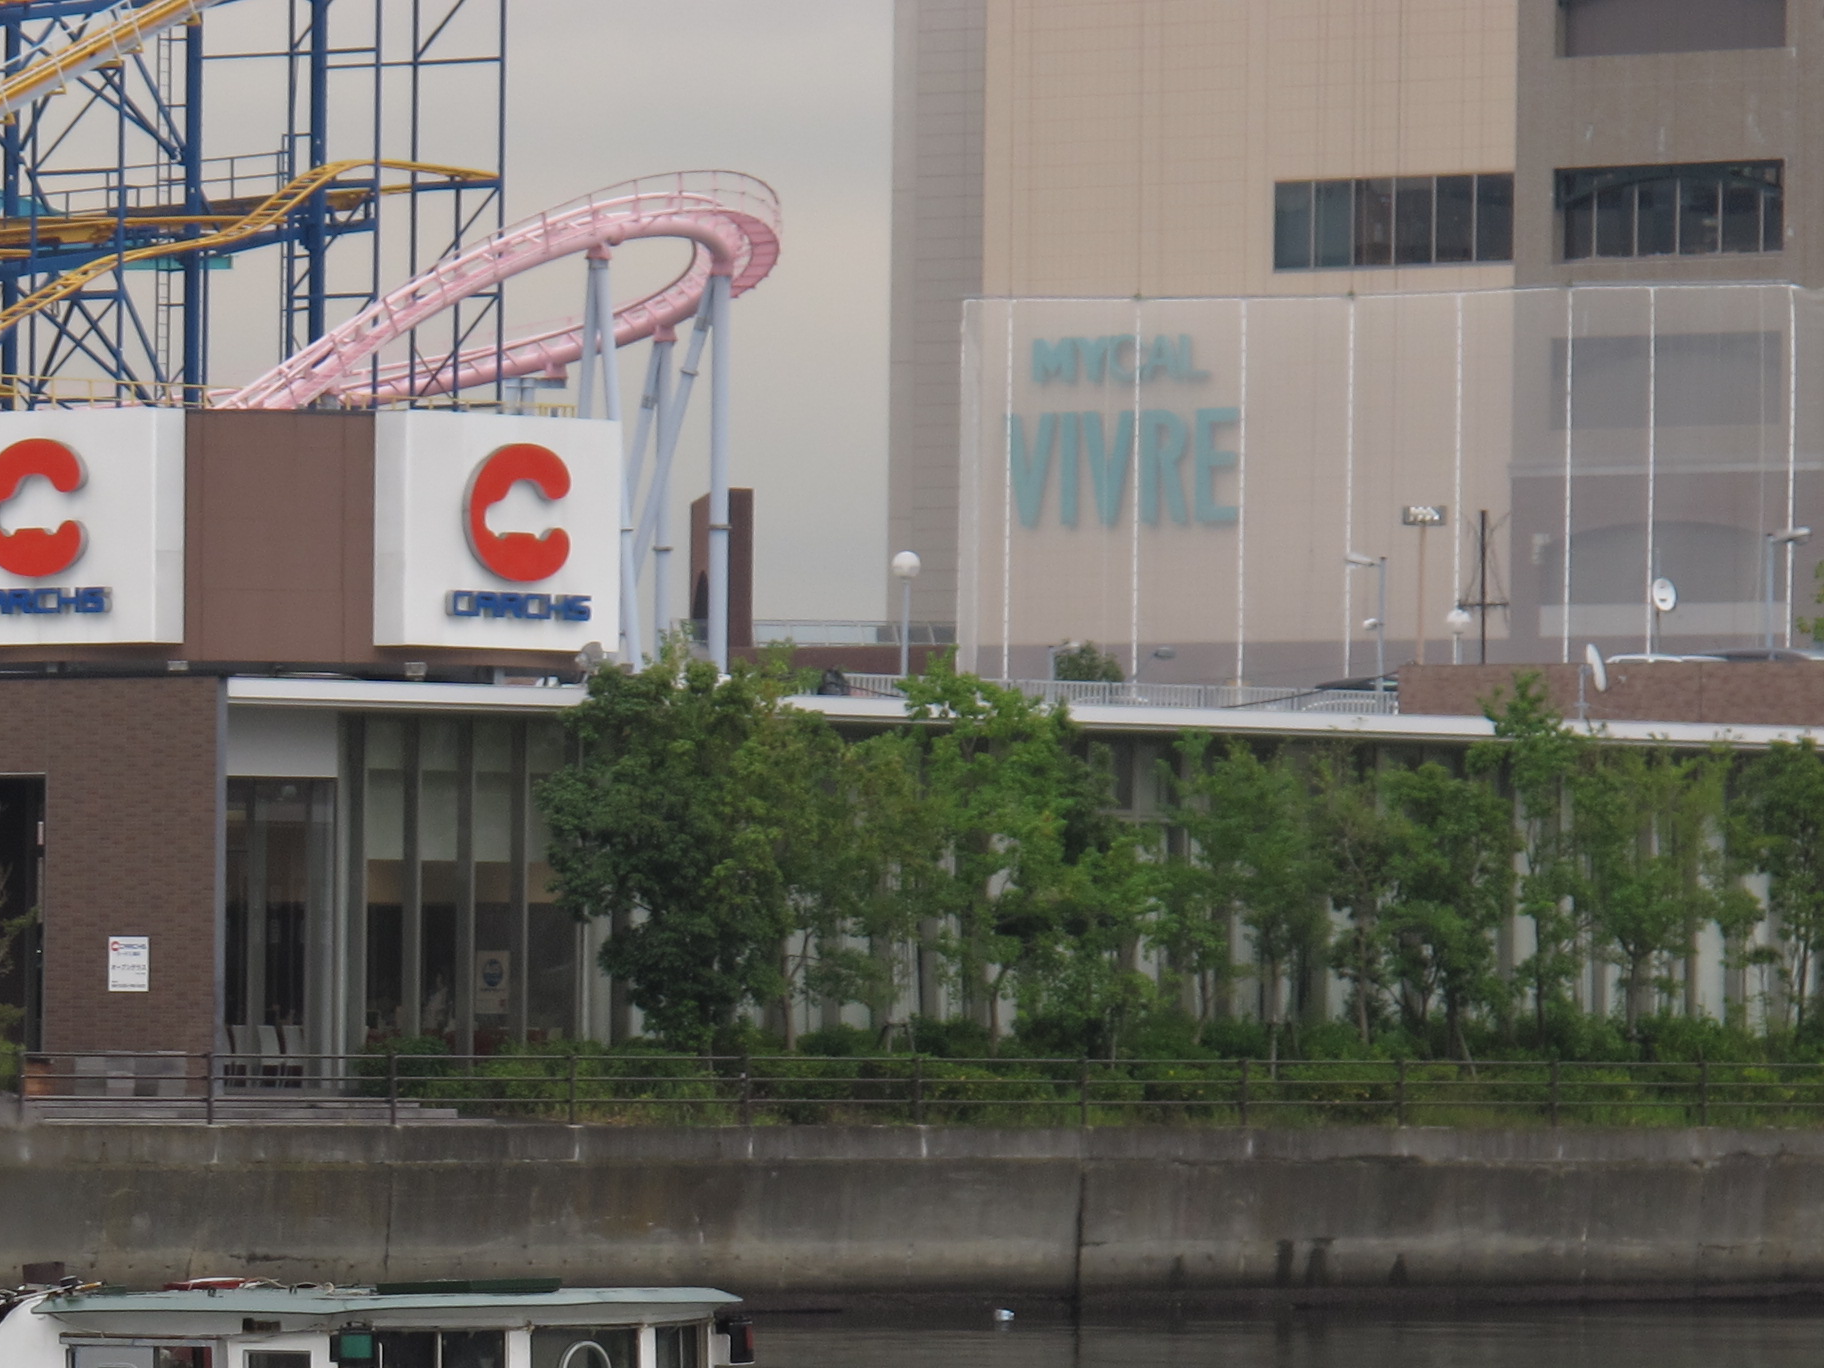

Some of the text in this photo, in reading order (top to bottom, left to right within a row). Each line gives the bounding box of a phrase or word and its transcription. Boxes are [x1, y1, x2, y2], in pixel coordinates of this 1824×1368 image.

[1032, 332, 1209, 384] MYCAL
[1005, 406, 1239, 529] VIVRE
[449, 590, 592, 621] CARCHS
